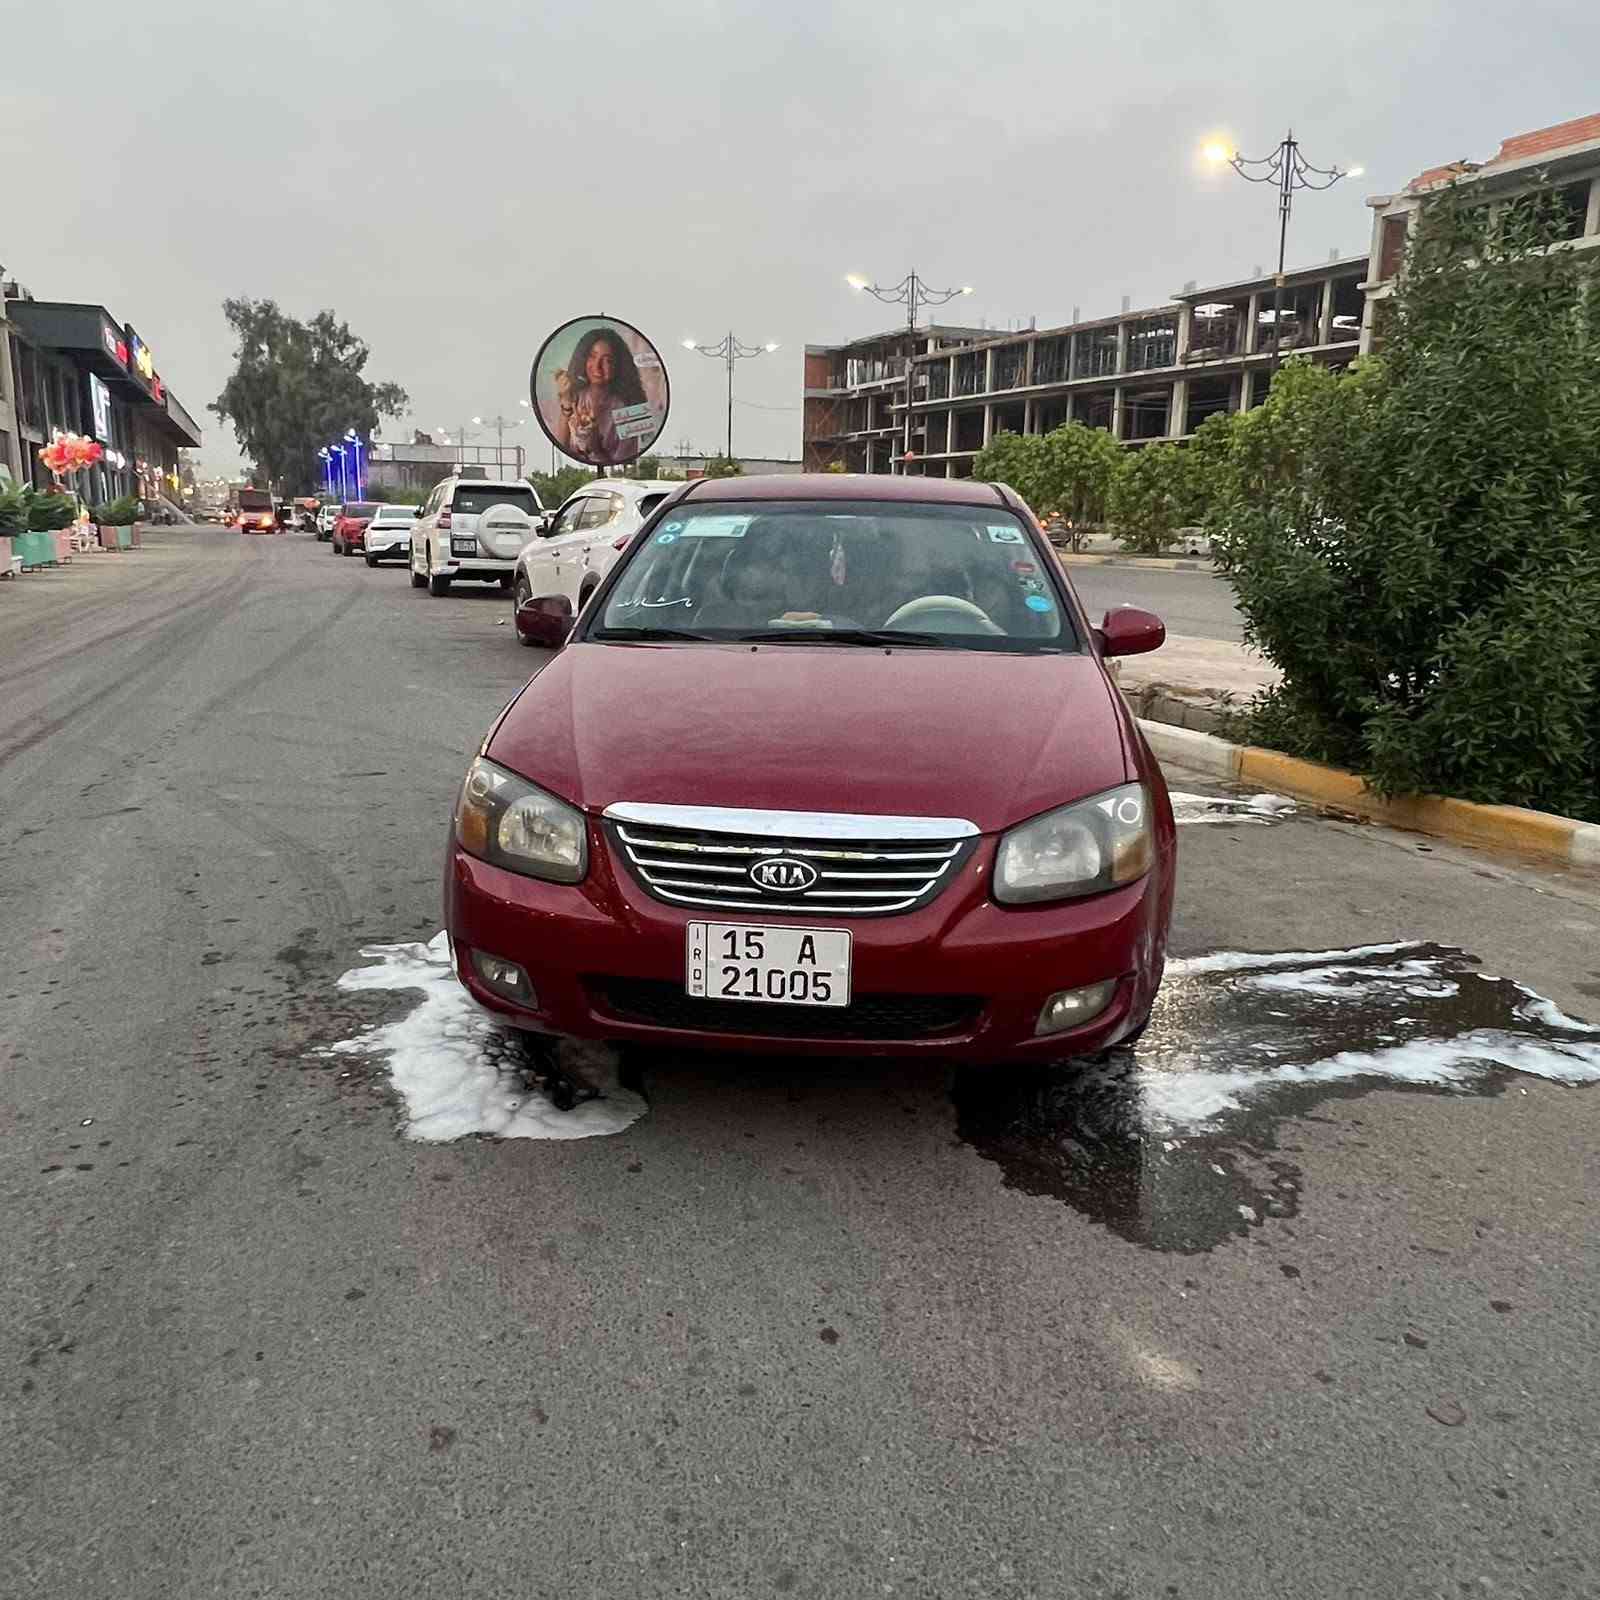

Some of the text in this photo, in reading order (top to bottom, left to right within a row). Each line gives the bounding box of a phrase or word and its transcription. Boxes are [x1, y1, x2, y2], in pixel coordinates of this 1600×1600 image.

[761, 865, 806, 885] KIA
[722, 930, 816, 965] 15 A
[721, 966, 832, 1001] 21005
